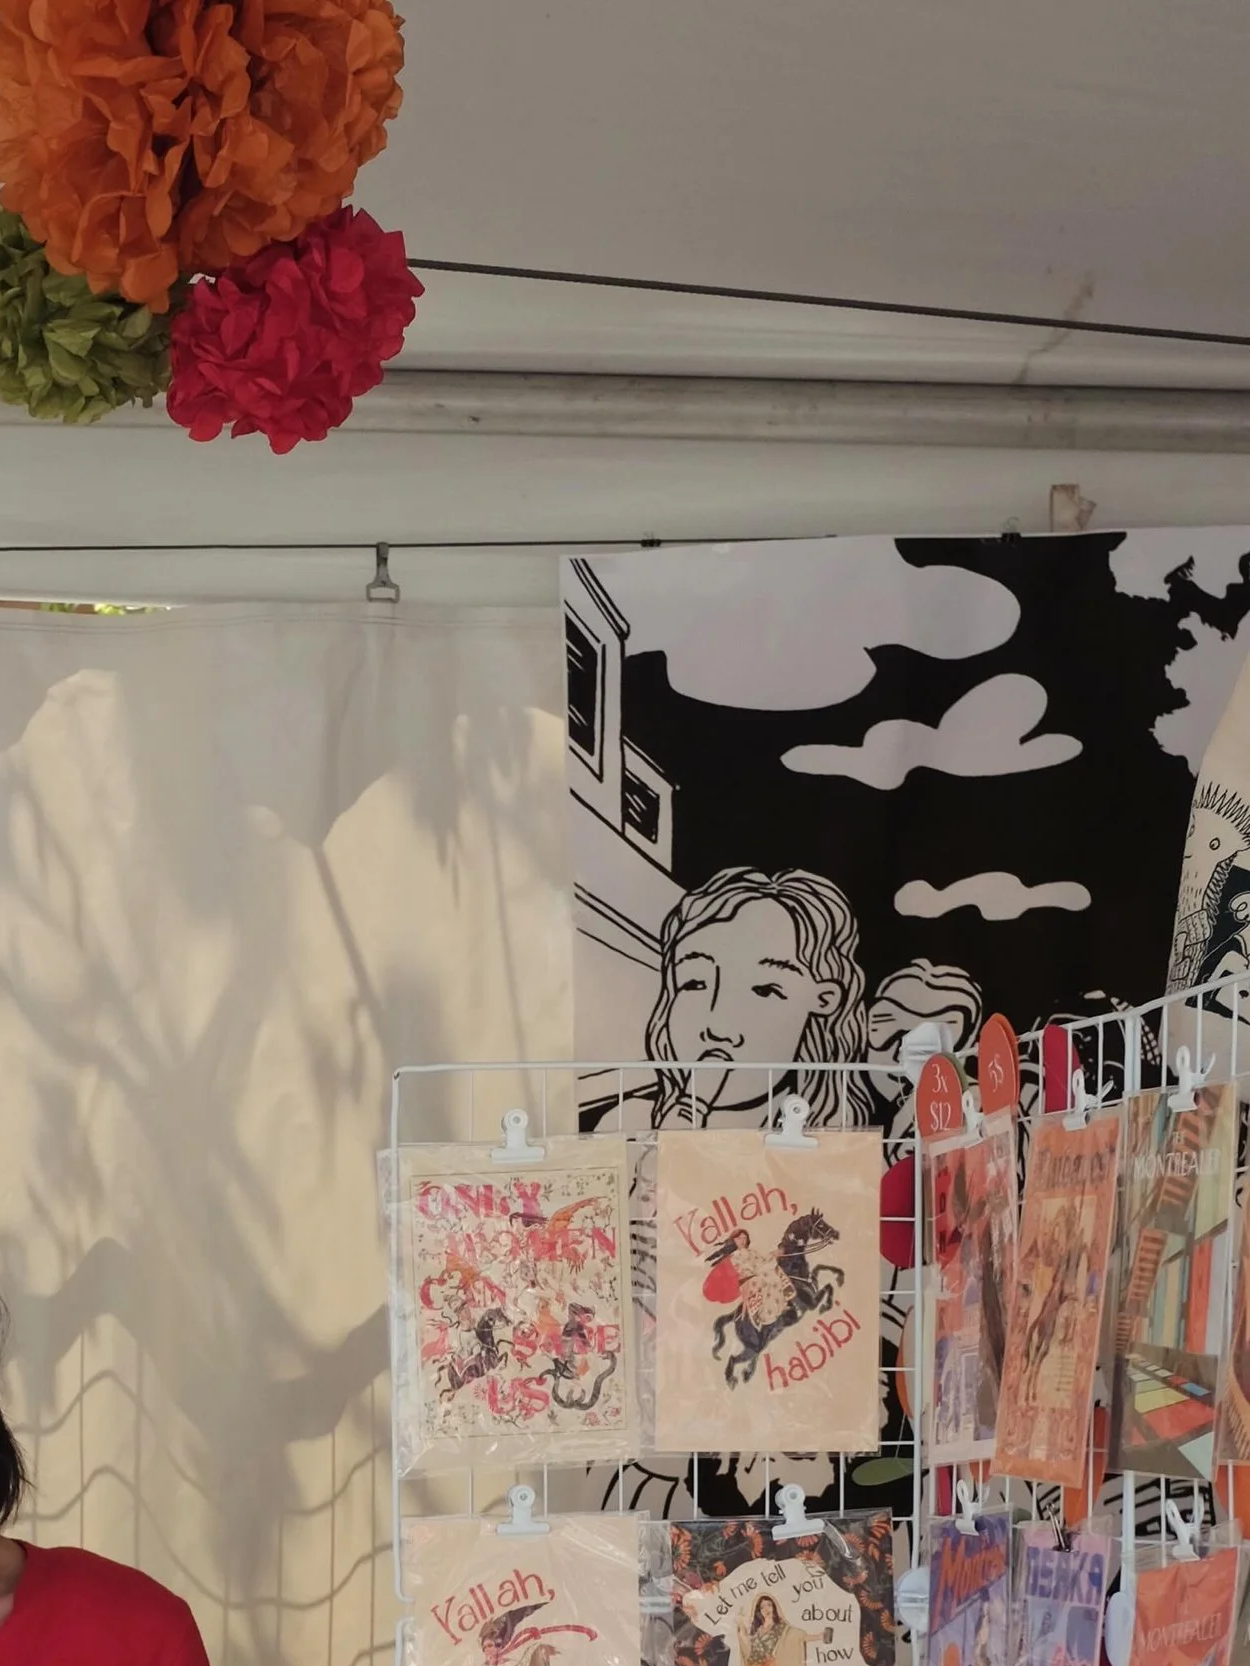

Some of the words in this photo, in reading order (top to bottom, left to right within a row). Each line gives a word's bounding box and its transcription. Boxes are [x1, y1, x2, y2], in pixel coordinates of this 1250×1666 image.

[764, 1300, 862, 1392] habibi
[705, 1597, 732, 1627] Let
[729, 1576, 758, 1600] me
[759, 1563, 786, 1588] tell
[792, 1576, 826, 1605] you
[801, 1604, 854, 1625] about
[815, 1645, 854, 1666] how
